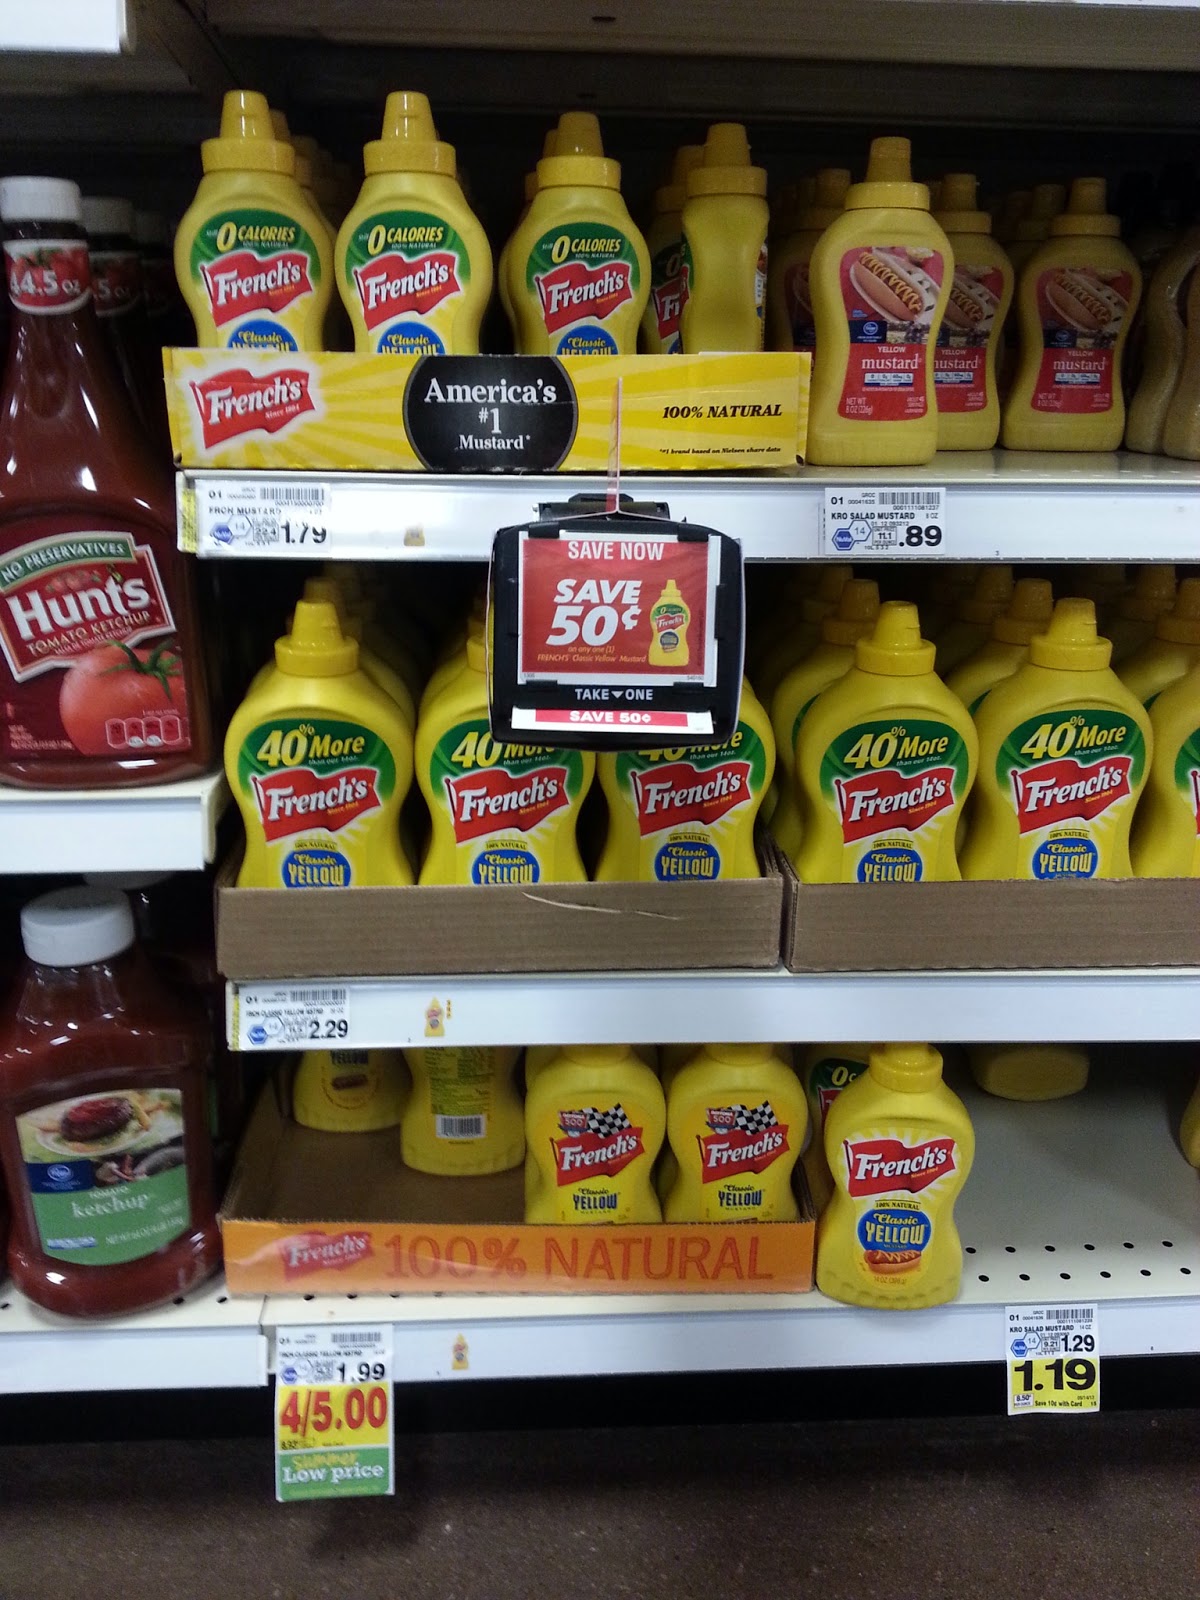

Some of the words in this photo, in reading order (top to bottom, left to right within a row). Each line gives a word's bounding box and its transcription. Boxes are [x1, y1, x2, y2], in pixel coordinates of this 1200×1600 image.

[217, 221, 237, 252] 0
[238, 225, 296, 242] CALORIES
[368, 224, 386, 256] 0
[387, 227, 444, 243] CALORIES
[551, 235, 571, 264] 0
[571, 239, 621, 253] CALORIES
[214, 260, 301, 305] French's
[365, 260, 448, 310] French's
[548, 270, 624, 314] French's
[238, 331, 282, 344] Classic
[387, 334, 429, 345] Classic
[568, 337, 606, 347] Classic
[862, 353, 919, 370] mustard
[1053, 357, 1105, 370] mustard
[205, 376, 302, 425] French's
[424, 377, 557, 404] America's
[478, 407, 502, 434] #1
[662, 406, 703, 419] 100%
[707, 404, 783, 418] NATURAL
[831, 497, 844, 505] 01
[281, 521, 327, 543] 1.79
[854, 527, 866, 535] 14
[899, 525, 942, 547] .89
[568, 541, 614, 560] SAVE
[620, 542, 665, 561] NOW
[1, 561, 26, 583] NO
[23, 542, 125, 571] PRESERVATIVES
[553, 578, 643, 605] SAVE
[27, 627, 88, 656] TOMATO
[91, 611, 151, 635] KETCHUP
[545, 604, 642, 646] 50¢
[537, 654, 569, 662] FRENCH'S
[572, 654, 593, 662] Classic
[594, 655, 617, 663] Yellow
[619, 655, 647, 663] Mustard
[575, 689, 609, 700] TAKE
[625, 689, 654, 700] ONE
[569, 711, 615, 723] SAVE
[619, 712, 652, 724] 50¢
[257, 723, 315, 767] 40%
[309, 734, 365, 758] More
[843, 725, 906, 769] 40%
[897, 736, 949, 760] More
[1020, 715, 1085, 760] 40%
[1075, 725, 1127, 749] More
[266, 777, 368, 822] French's
[459, 777, 558, 822] French's
[644, 771, 741, 814] French's
[848, 777, 946, 822] French's
[1025, 766, 1123, 812] French's
[294, 854, 337, 865] Classic
[484, 854, 527, 864] Classic
[668, 846, 708, 856] Classic
[871, 853, 911, 863] Classic
[1047, 844, 1087, 853] Classic
[478, 864, 534, 883] YELLOW
[661, 856, 715, 877] YELLOW
[864, 863, 917, 882] YELLOW
[1039, 853, 1092, 873] YELLOW
[288, 864, 345, 885] YELLOW
[309, 1019, 348, 1039] 2.29
[565, 1118, 582, 1126] 500
[713, 1115, 731, 1123] 500
[561, 1135, 637, 1170] French's
[707, 1132, 782, 1167] French's
[855, 1147, 947, 1180] French's
[71, 1194, 149, 1218] ketchup
[573, 1193, 617, 1210] YELLOW
[718, 1190, 762, 1207] YELLOW
[891, 1202, 920, 1210] NATURAL
[873, 1213, 919, 1224] Classic
[866, 1222, 925, 1244] YELLOW
[288, 1234, 366, 1267] French's
[384, 1235, 526, 1279] 100%
[544, 1235, 773, 1280] NATURAL
[1045, 1324, 1075, 1332] MUSTARD
[1061, 1334, 1095, 1352] 1.29
[337, 1361, 385, 1382] 1.99
[1014, 1358, 1096, 1391] 1.19
[280, 1387, 388, 1437] 4/5.00
[282, 1466, 326, 1484] Low
[330, 1462, 384, 1485] price
